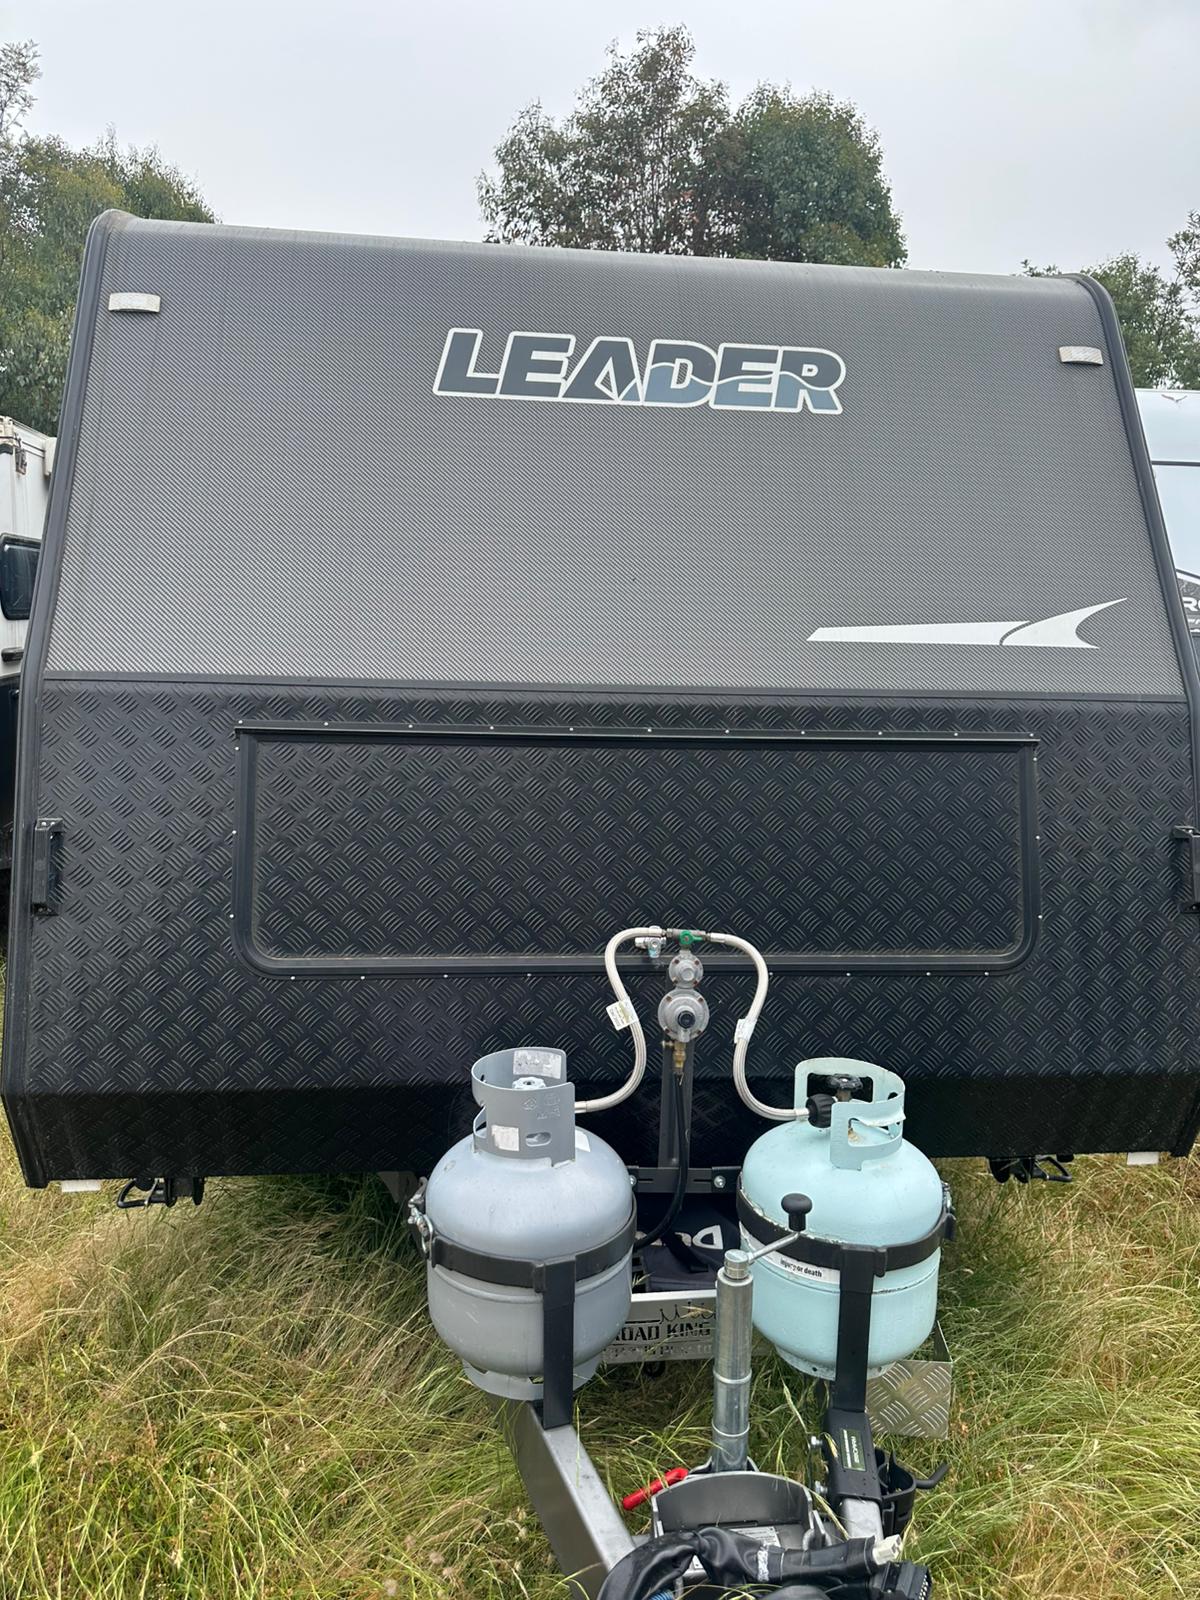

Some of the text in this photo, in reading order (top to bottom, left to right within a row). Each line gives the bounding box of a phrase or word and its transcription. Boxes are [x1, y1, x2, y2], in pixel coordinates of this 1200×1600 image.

[433, 328, 846, 414] LEADER
[804, 1267, 822, 1277] death
[667, 1322, 711, 1338] KING
